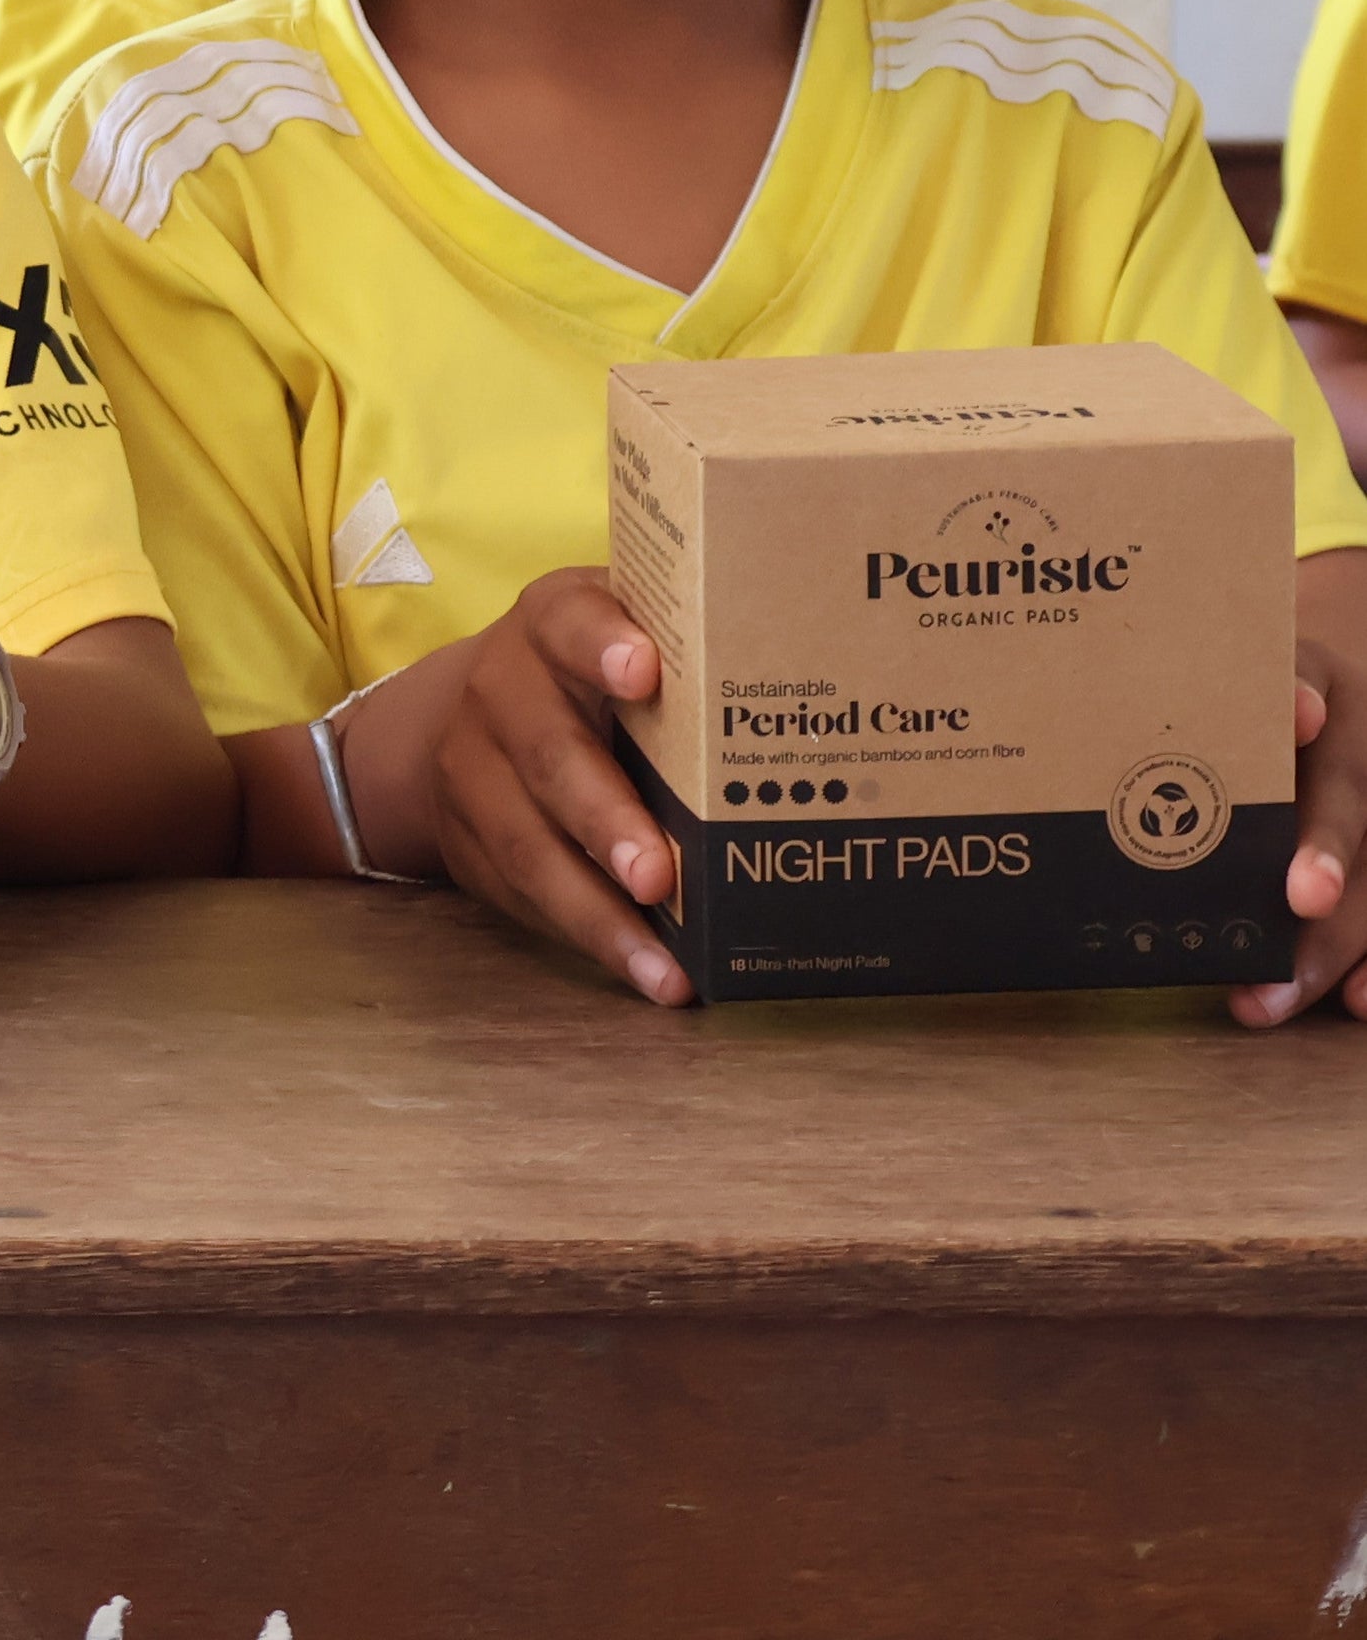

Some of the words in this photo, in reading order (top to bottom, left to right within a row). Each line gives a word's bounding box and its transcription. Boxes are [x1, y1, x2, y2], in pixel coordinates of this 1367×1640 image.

[999, 489, 1038, 509] PERIOD
[1039, 508, 1059, 533] CARE
[918, 610, 1015, 628] ORGANIC
[1026, 608, 1080, 623] PADS
[721, 679, 837, 698] Sustainable
[723, 700, 860, 737] Period
[870, 702, 970, 736] Care
[721, 751, 765, 765] Made
[767, 751, 800, 765] with
[802, 750, 859, 767] organic
[860, 748, 922, 764] bamboo
[925, 746, 952, 761] and
[955, 747, 989, 759] corn
[992, 744, 1025, 758] fibre
[726, 838, 887, 883] NIGHT
[897, 832, 1032, 879] PADS
[730, 959, 746, 972] 18
[748, 957, 814, 972] Ultra-thin
[816, 956, 853, 973] Night
[855, 955, 891, 969] Pads
